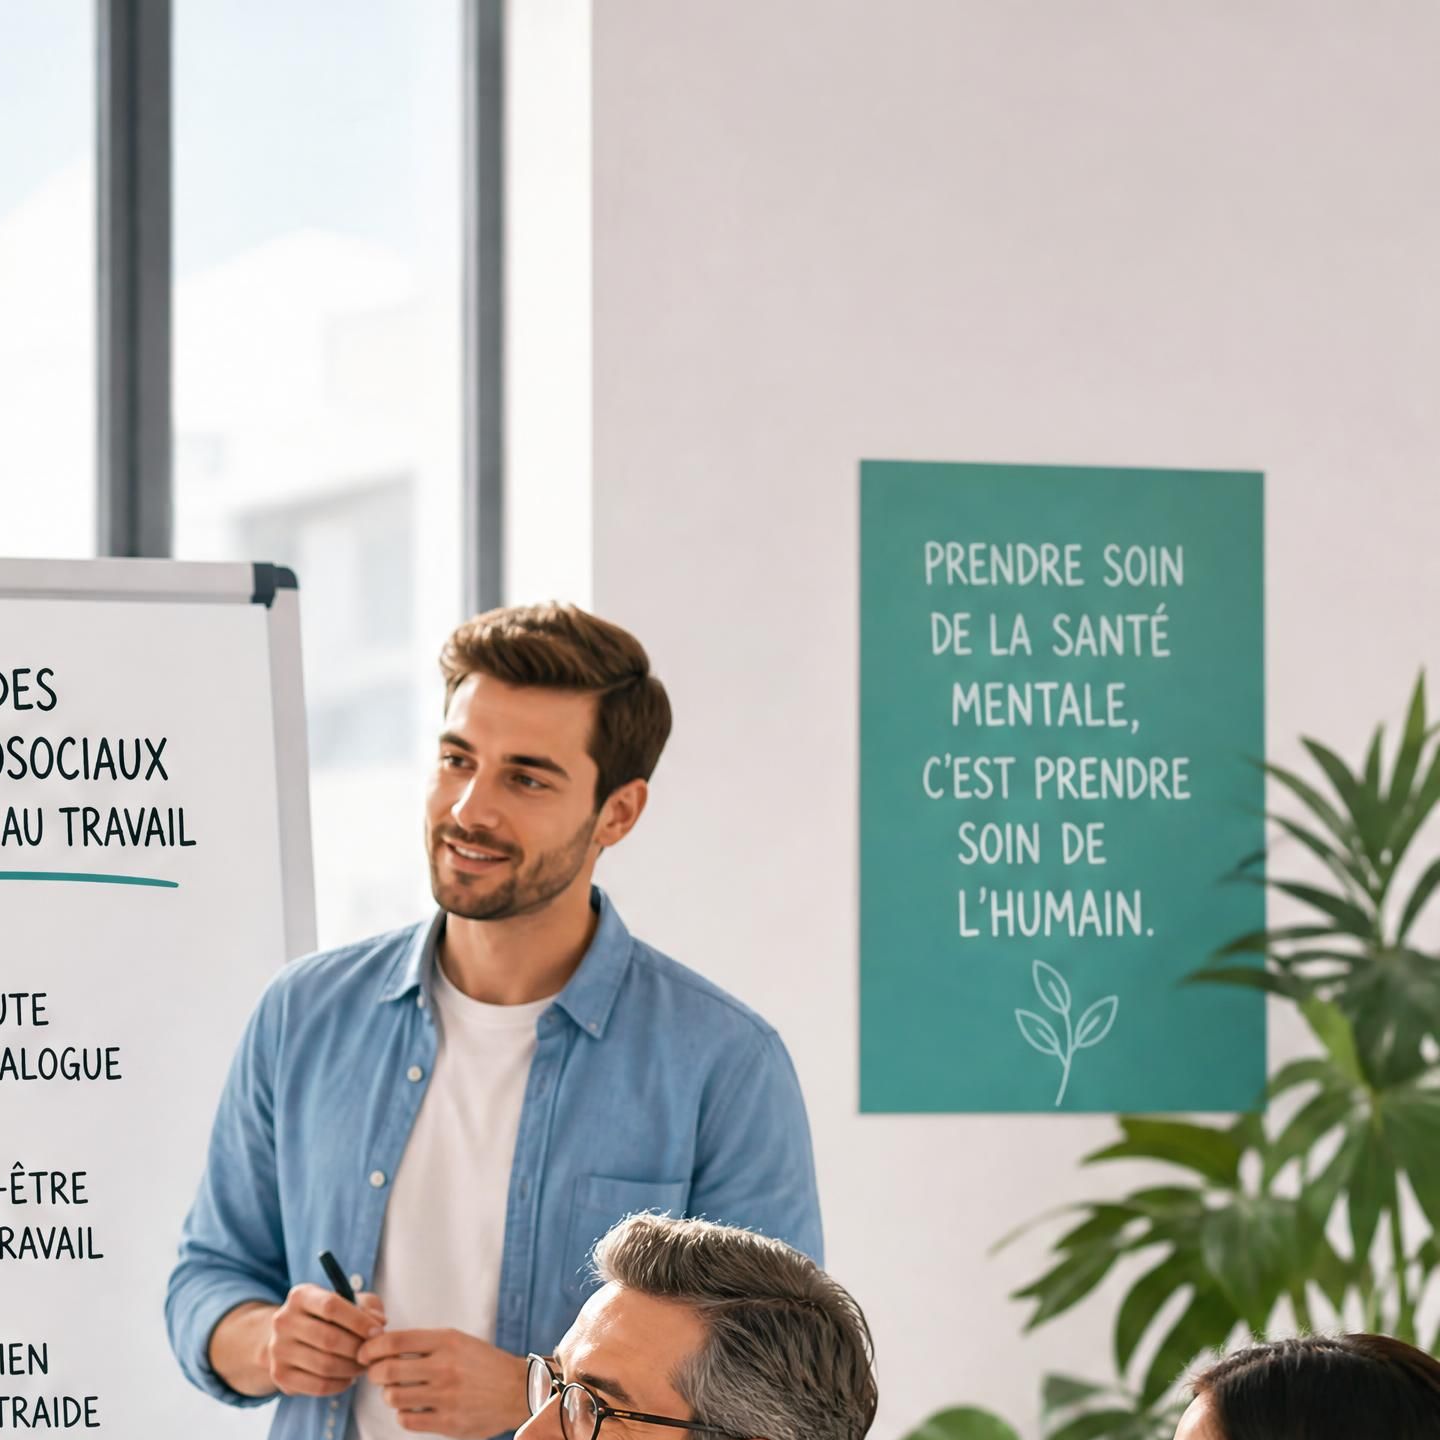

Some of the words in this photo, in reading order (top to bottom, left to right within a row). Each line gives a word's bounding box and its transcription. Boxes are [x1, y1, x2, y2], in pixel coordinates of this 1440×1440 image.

[924, 540, 1085, 587] PRENDRE
[1103, 543, 1184, 588] SOIN
[930, 611, 973, 656] DE
[989, 613, 1033, 657] LA
[1052, 602, 1171, 658] SANTÉ
[952, 681, 1140, 734] MENTALE,
[922, 753, 1016, 800] C'EST
[1034, 756, 1191, 800] PRENDRE
[1, 806, 43, 847] AU
[58, 806, 197, 848] TRAVAIL
[958, 821, 1040, 865] SOIN
[1061, 822, 1107, 865] DE
[958, 886, 1154, 938] L'HUMAIN.
